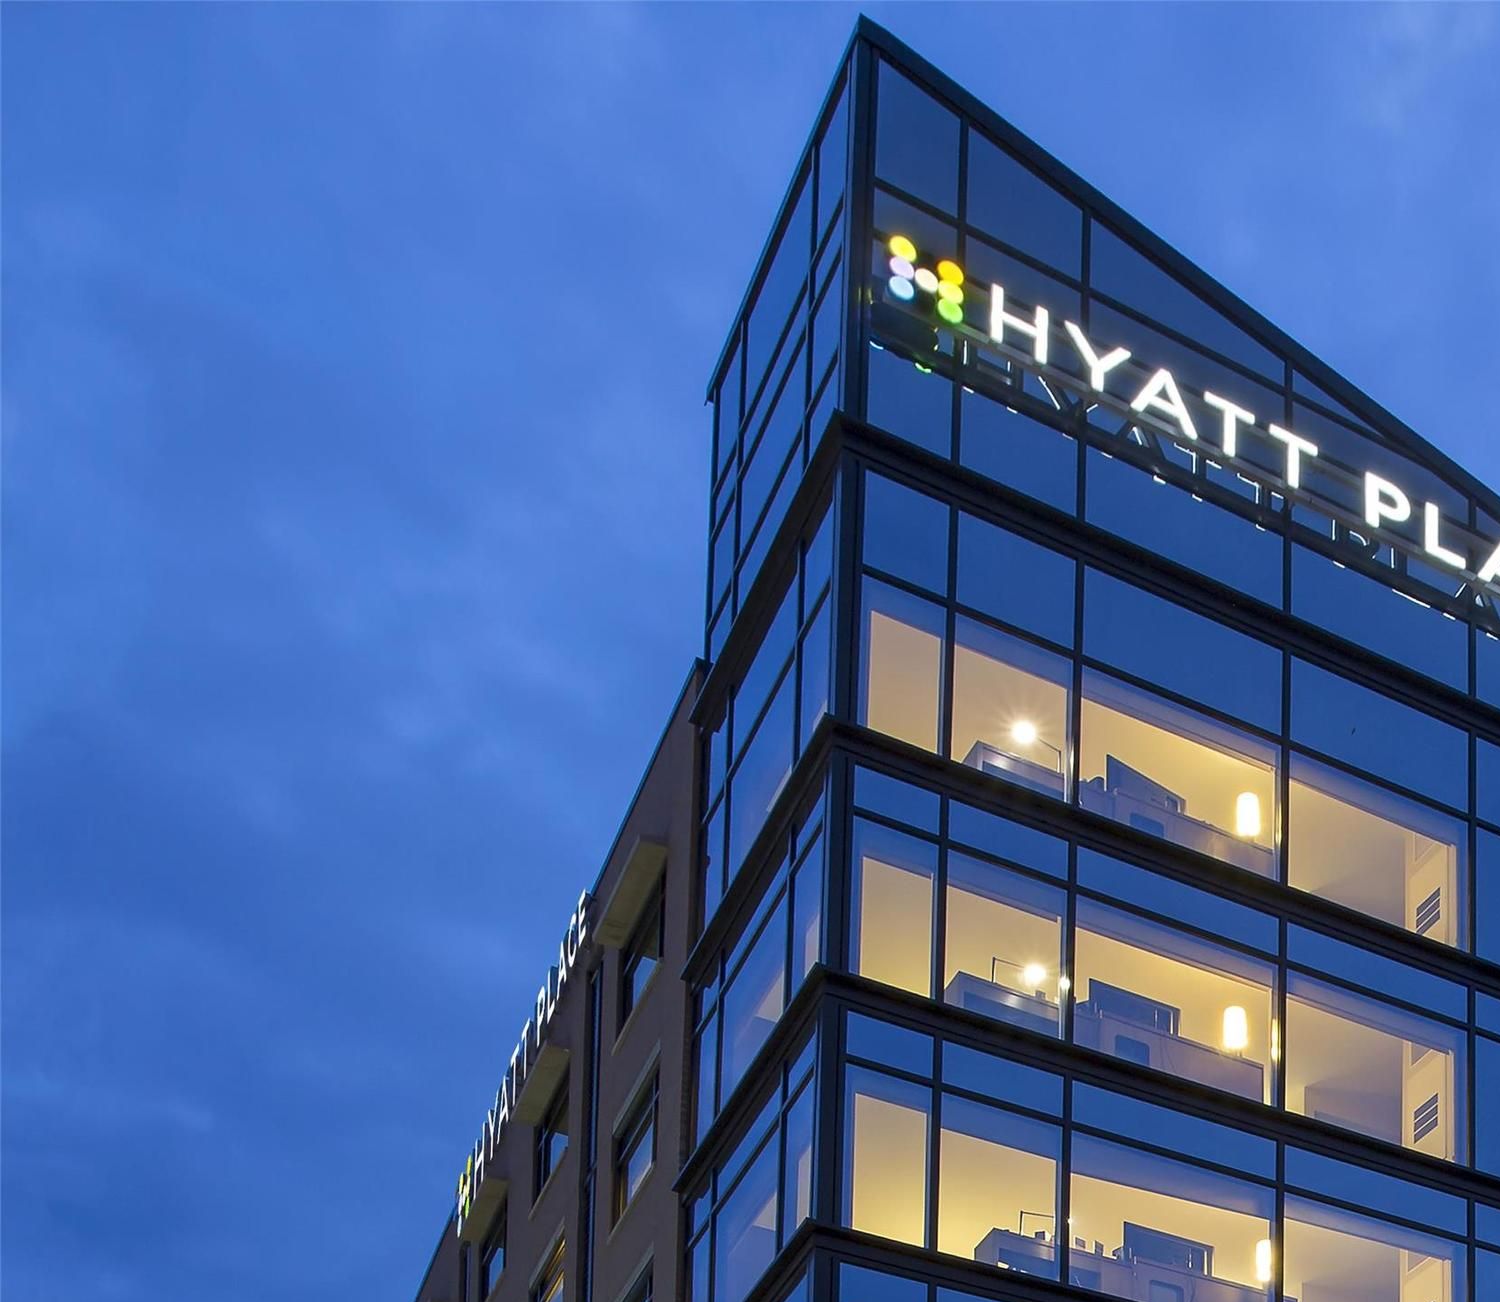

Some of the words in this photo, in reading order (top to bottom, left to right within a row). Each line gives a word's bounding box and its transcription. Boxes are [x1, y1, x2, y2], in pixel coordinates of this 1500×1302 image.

[989, 283, 1319, 490] HYATT
[473, 1017, 531, 1200] HYATT
[536, 888, 587, 1047] PLACE
